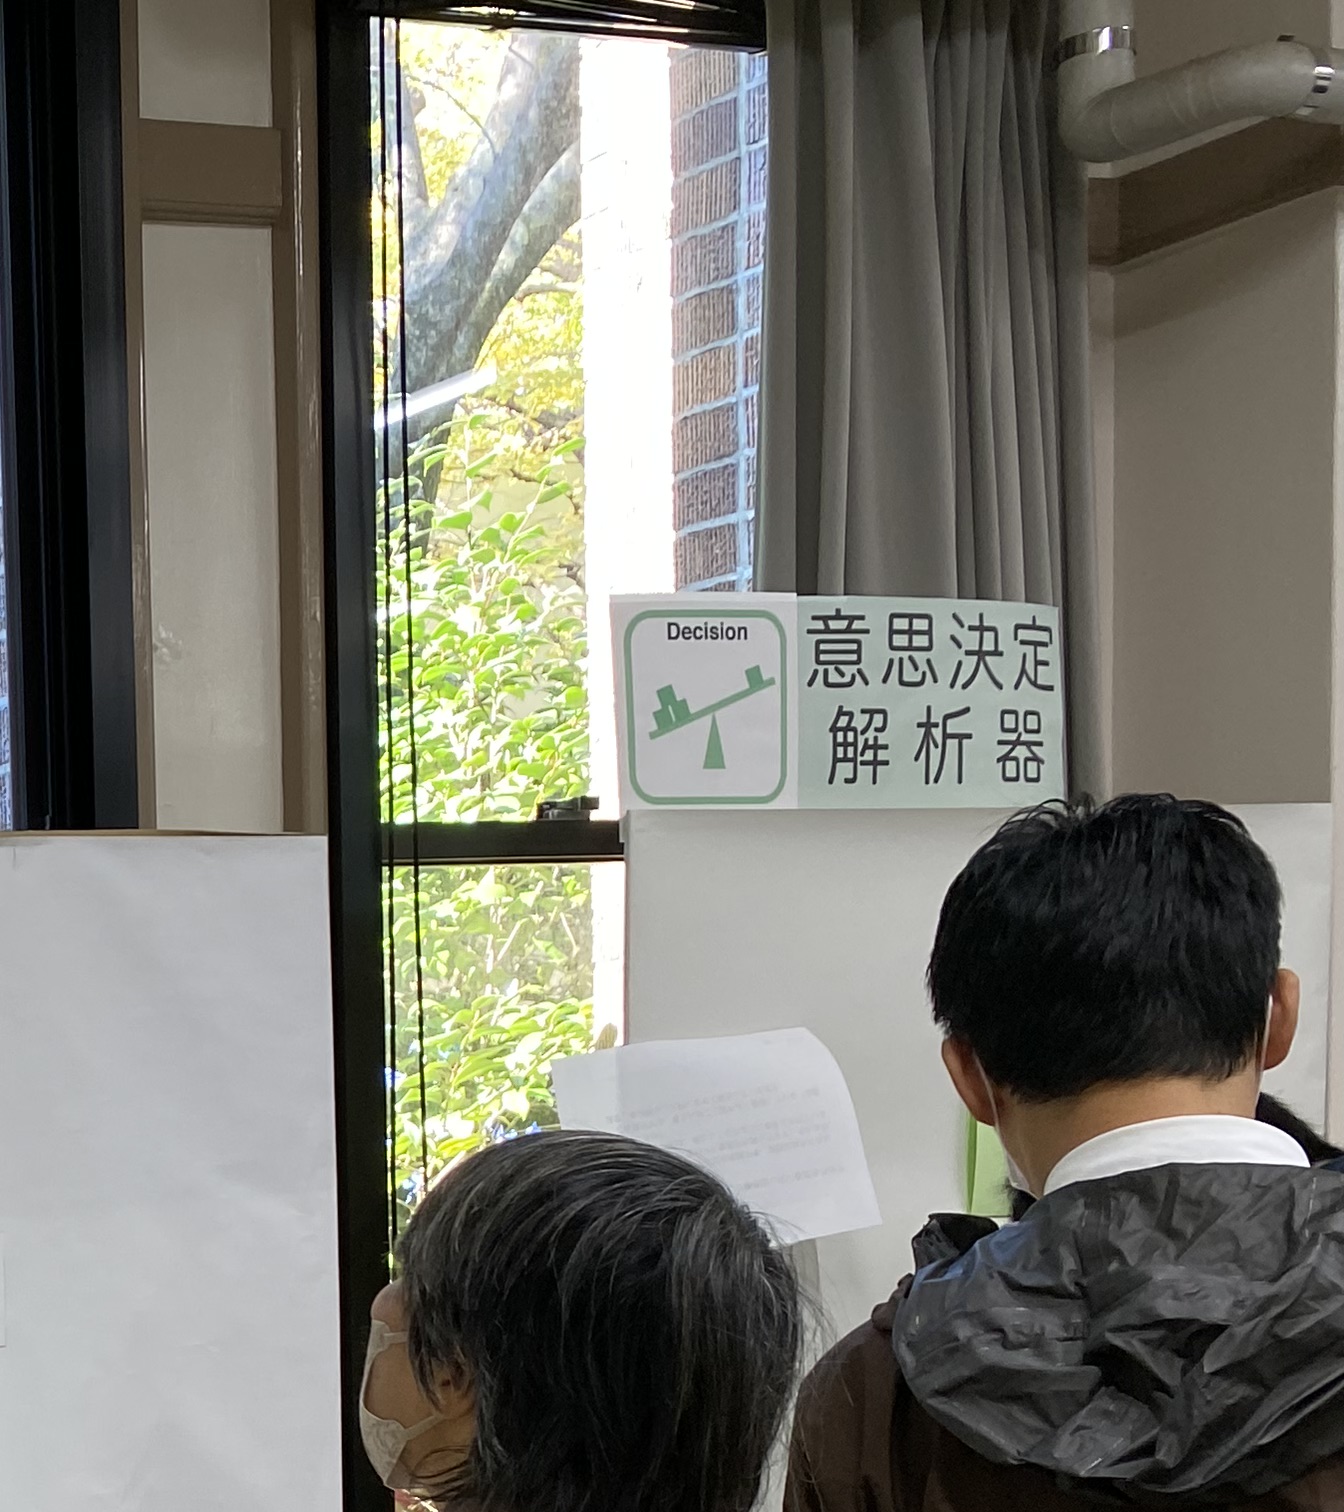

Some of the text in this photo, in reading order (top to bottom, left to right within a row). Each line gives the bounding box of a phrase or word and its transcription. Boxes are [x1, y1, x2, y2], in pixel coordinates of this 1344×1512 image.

[666, 621, 749, 642] Decision
[805, 607, 1056, 693] 意思決定
[826, 704, 1047, 787] 解析器
